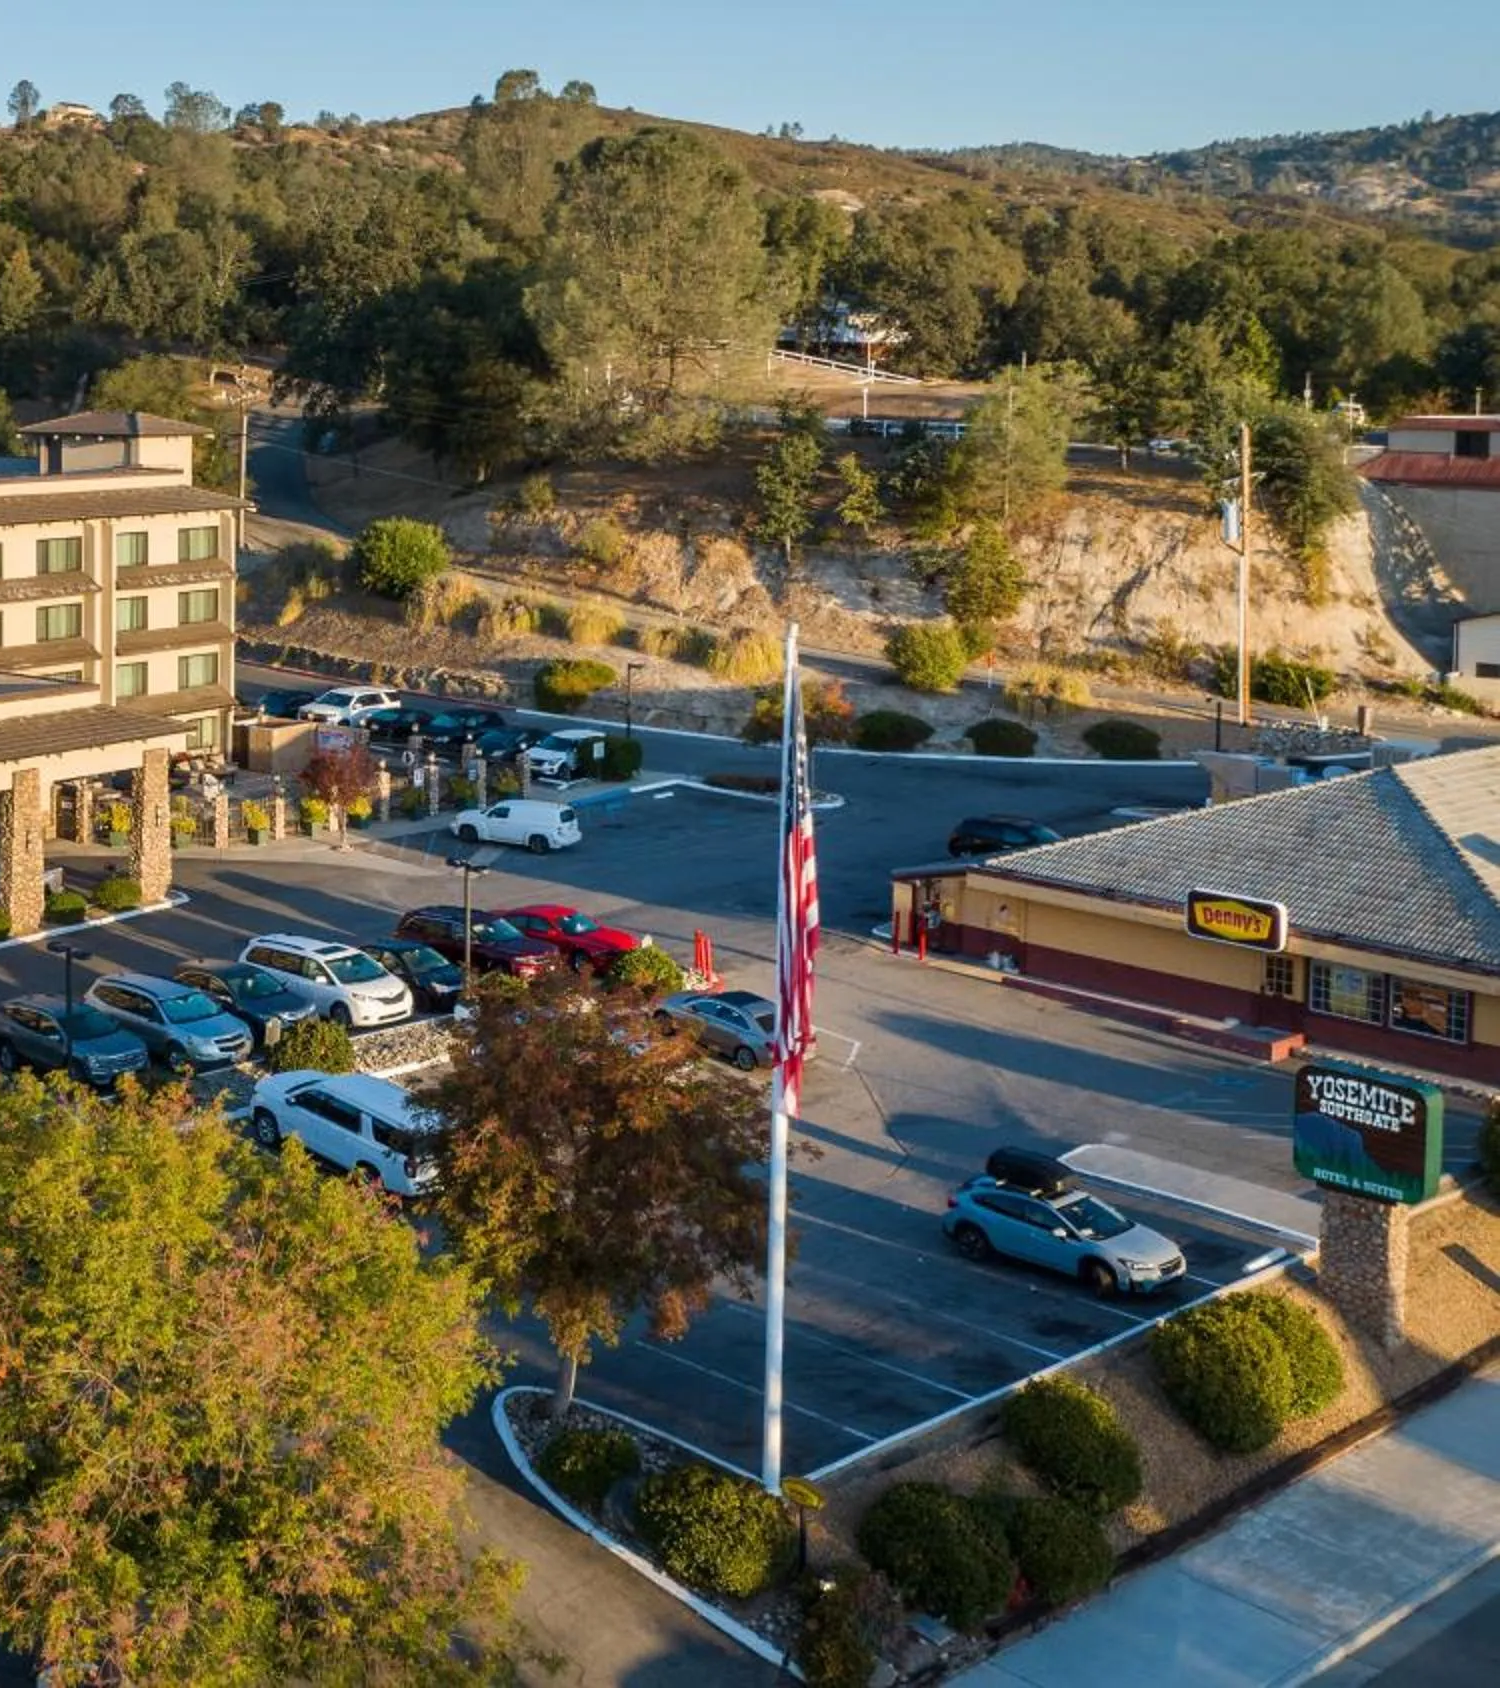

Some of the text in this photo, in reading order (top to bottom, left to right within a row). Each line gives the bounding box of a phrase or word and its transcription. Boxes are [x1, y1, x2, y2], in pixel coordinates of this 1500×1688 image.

[1202, 906, 1262, 933] Denny's
[1307, 1075, 1415, 1125] YOSEMITE
[1319, 1100, 1400, 1132] SOUTHGATE
[1313, 1167, 1349, 1187] HOTEL
[1363, 1181, 1404, 1200] SUITES
